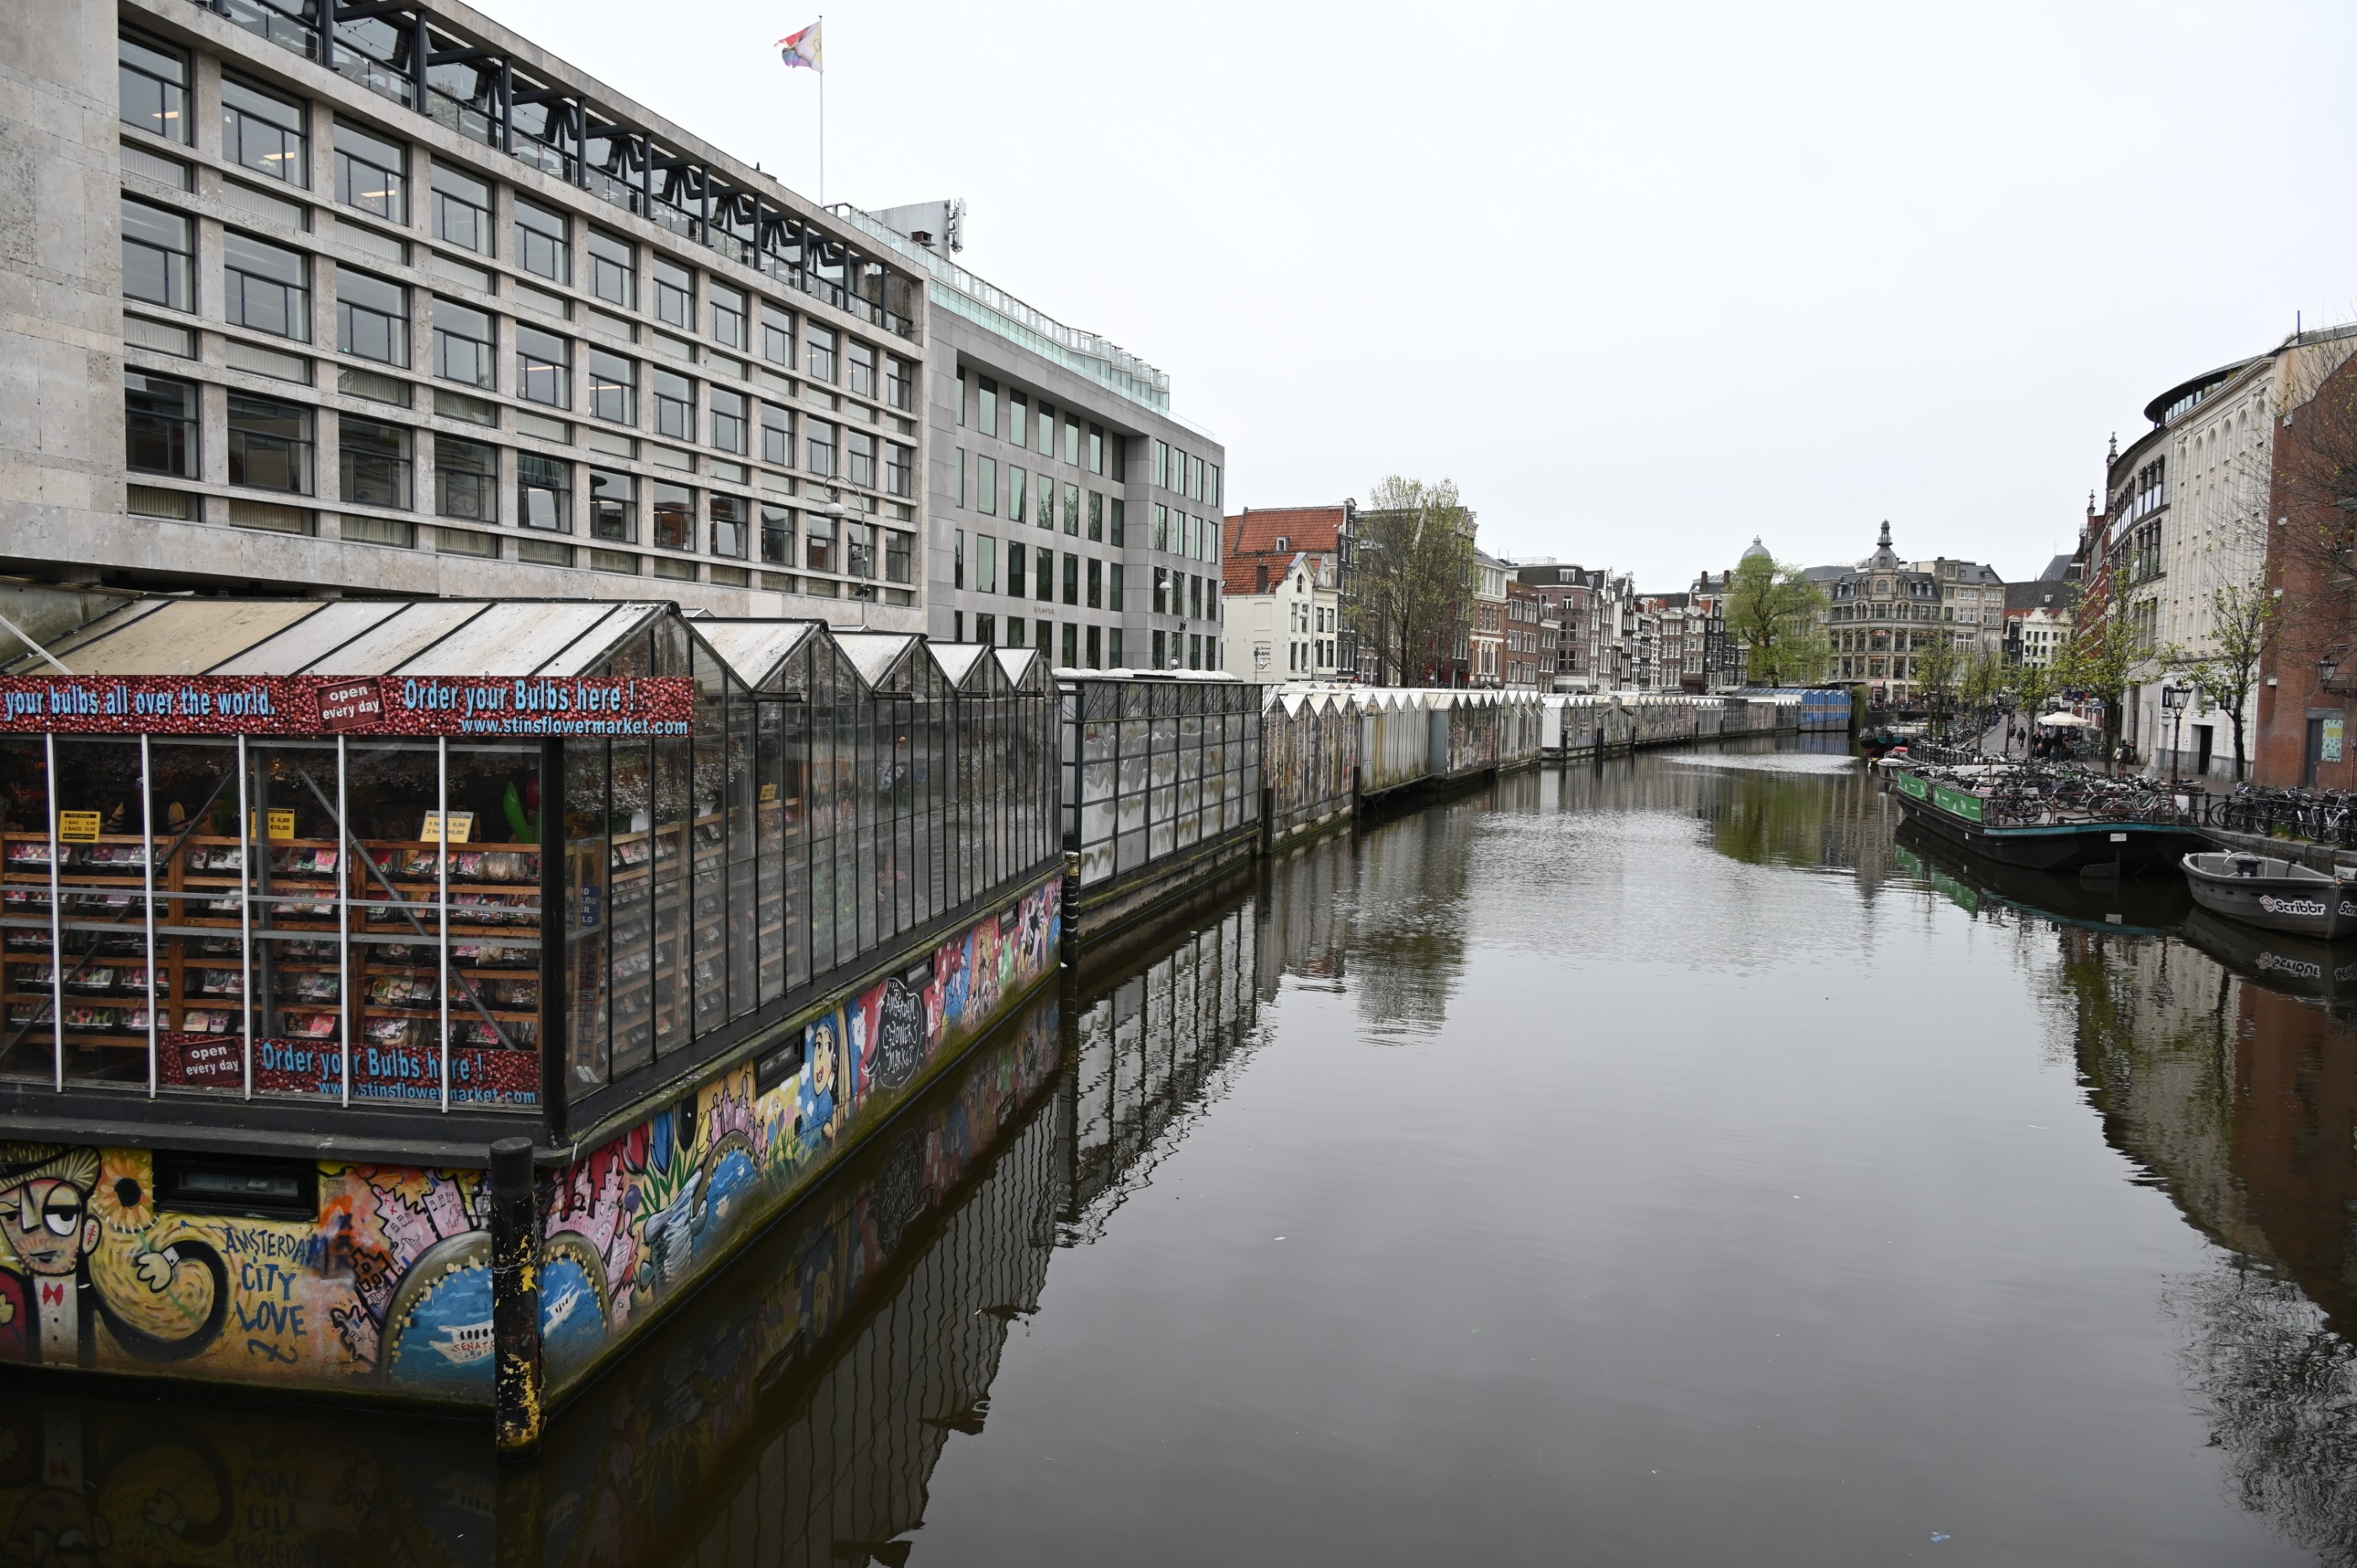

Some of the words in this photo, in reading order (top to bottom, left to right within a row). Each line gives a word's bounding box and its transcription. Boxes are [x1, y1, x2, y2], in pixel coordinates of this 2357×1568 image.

[5, 693, 44, 721] your
[51, 685, 99, 715] bulbs
[105, 685, 129, 715] all
[136, 693, 174, 715] over
[181, 686, 211, 715] the
[217, 686, 277, 715] world.
[329, 686, 368, 703] open
[405, 678, 459, 710] Order
[465, 687, 507, 717] your
[515, 679, 569, 710] Bulbs
[577, 680, 621, 710] here
[322, 705, 354, 720] every
[359, 700, 380, 713] day
[461, 716, 688, 735] www.stinsflowermarket.com
[2275, 901, 2323, 914] Scribbr
[2339, 902, 2357, 915] Scri
[191, 1045, 227, 1060] open
[262, 1042, 314, 1072] Order
[320, 1053, 360, 1081] yor
[368, 1048, 420, 1077] Bulbs
[427, 1050, 470, 1080] hre
[186, 1063, 216, 1076] every
[219, 1059, 239, 1071] day
[221, 1226, 329, 1271] AMSTERDAM
[242, 1262, 297, 1301] CITY
[236, 1300, 308, 1337] LOVE
[451, 1341, 495, 1353] SENATO
[464, 1347, 493, 1358] CRUIS
